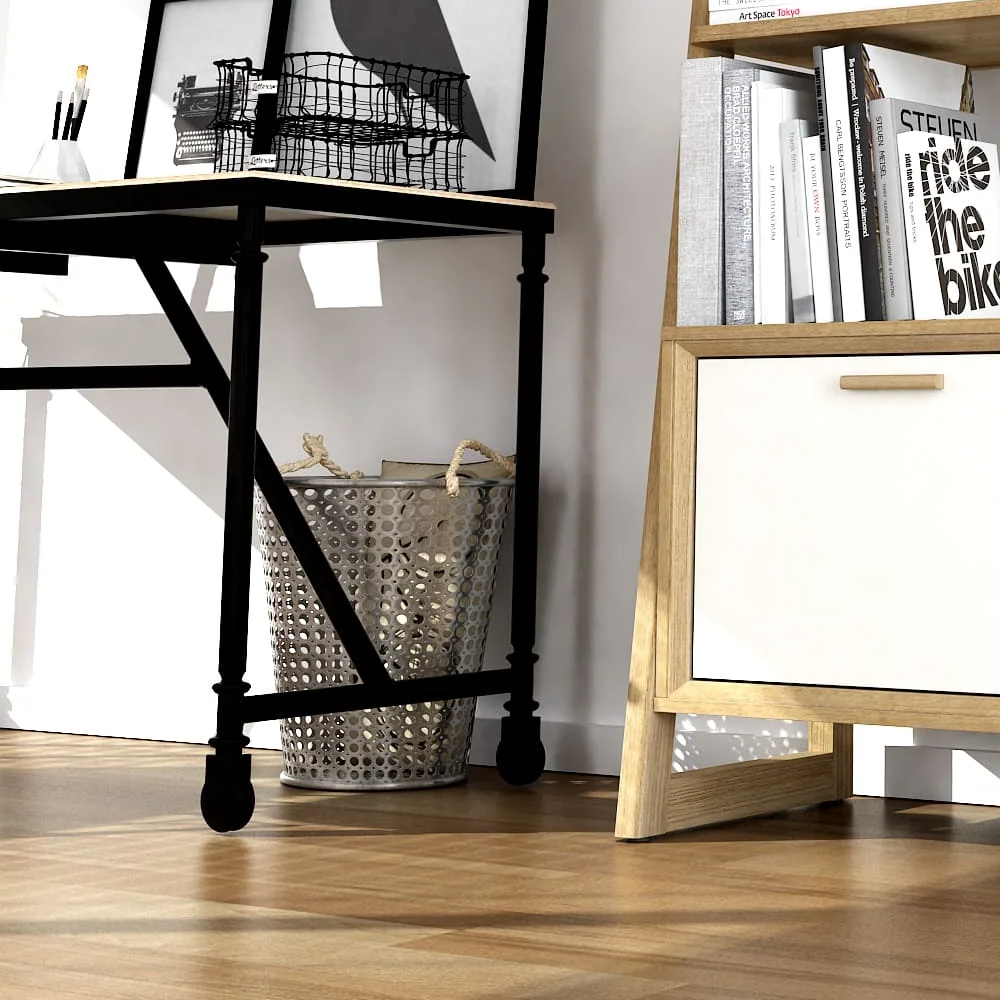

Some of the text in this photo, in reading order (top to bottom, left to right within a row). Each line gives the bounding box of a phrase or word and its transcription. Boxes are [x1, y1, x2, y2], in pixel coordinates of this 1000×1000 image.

[739, 7, 800, 21] Art Space Tokyo
[732, 85, 741, 114] BRAD
[724, 86, 732, 154] OCCUPATION
[741, 84, 752, 242] ALLIED WORKS ARCHITECTURE
[855, 143, 863, 176] welcome
[879, 150, 887, 179] MEISEL
[905, 153, 913, 168] ride
[919, 136, 991, 197] ride
[810, 165, 818, 188] YOUR
[835, 119, 852, 249] CARL BENGTSSON PORTRAITS
[907, 181, 915, 198] bike
[812, 189, 820, 213] OWN
[859, 184, 868, 205] Polish
[861, 205, 870, 238] diamond
[924, 196, 985, 256] the
